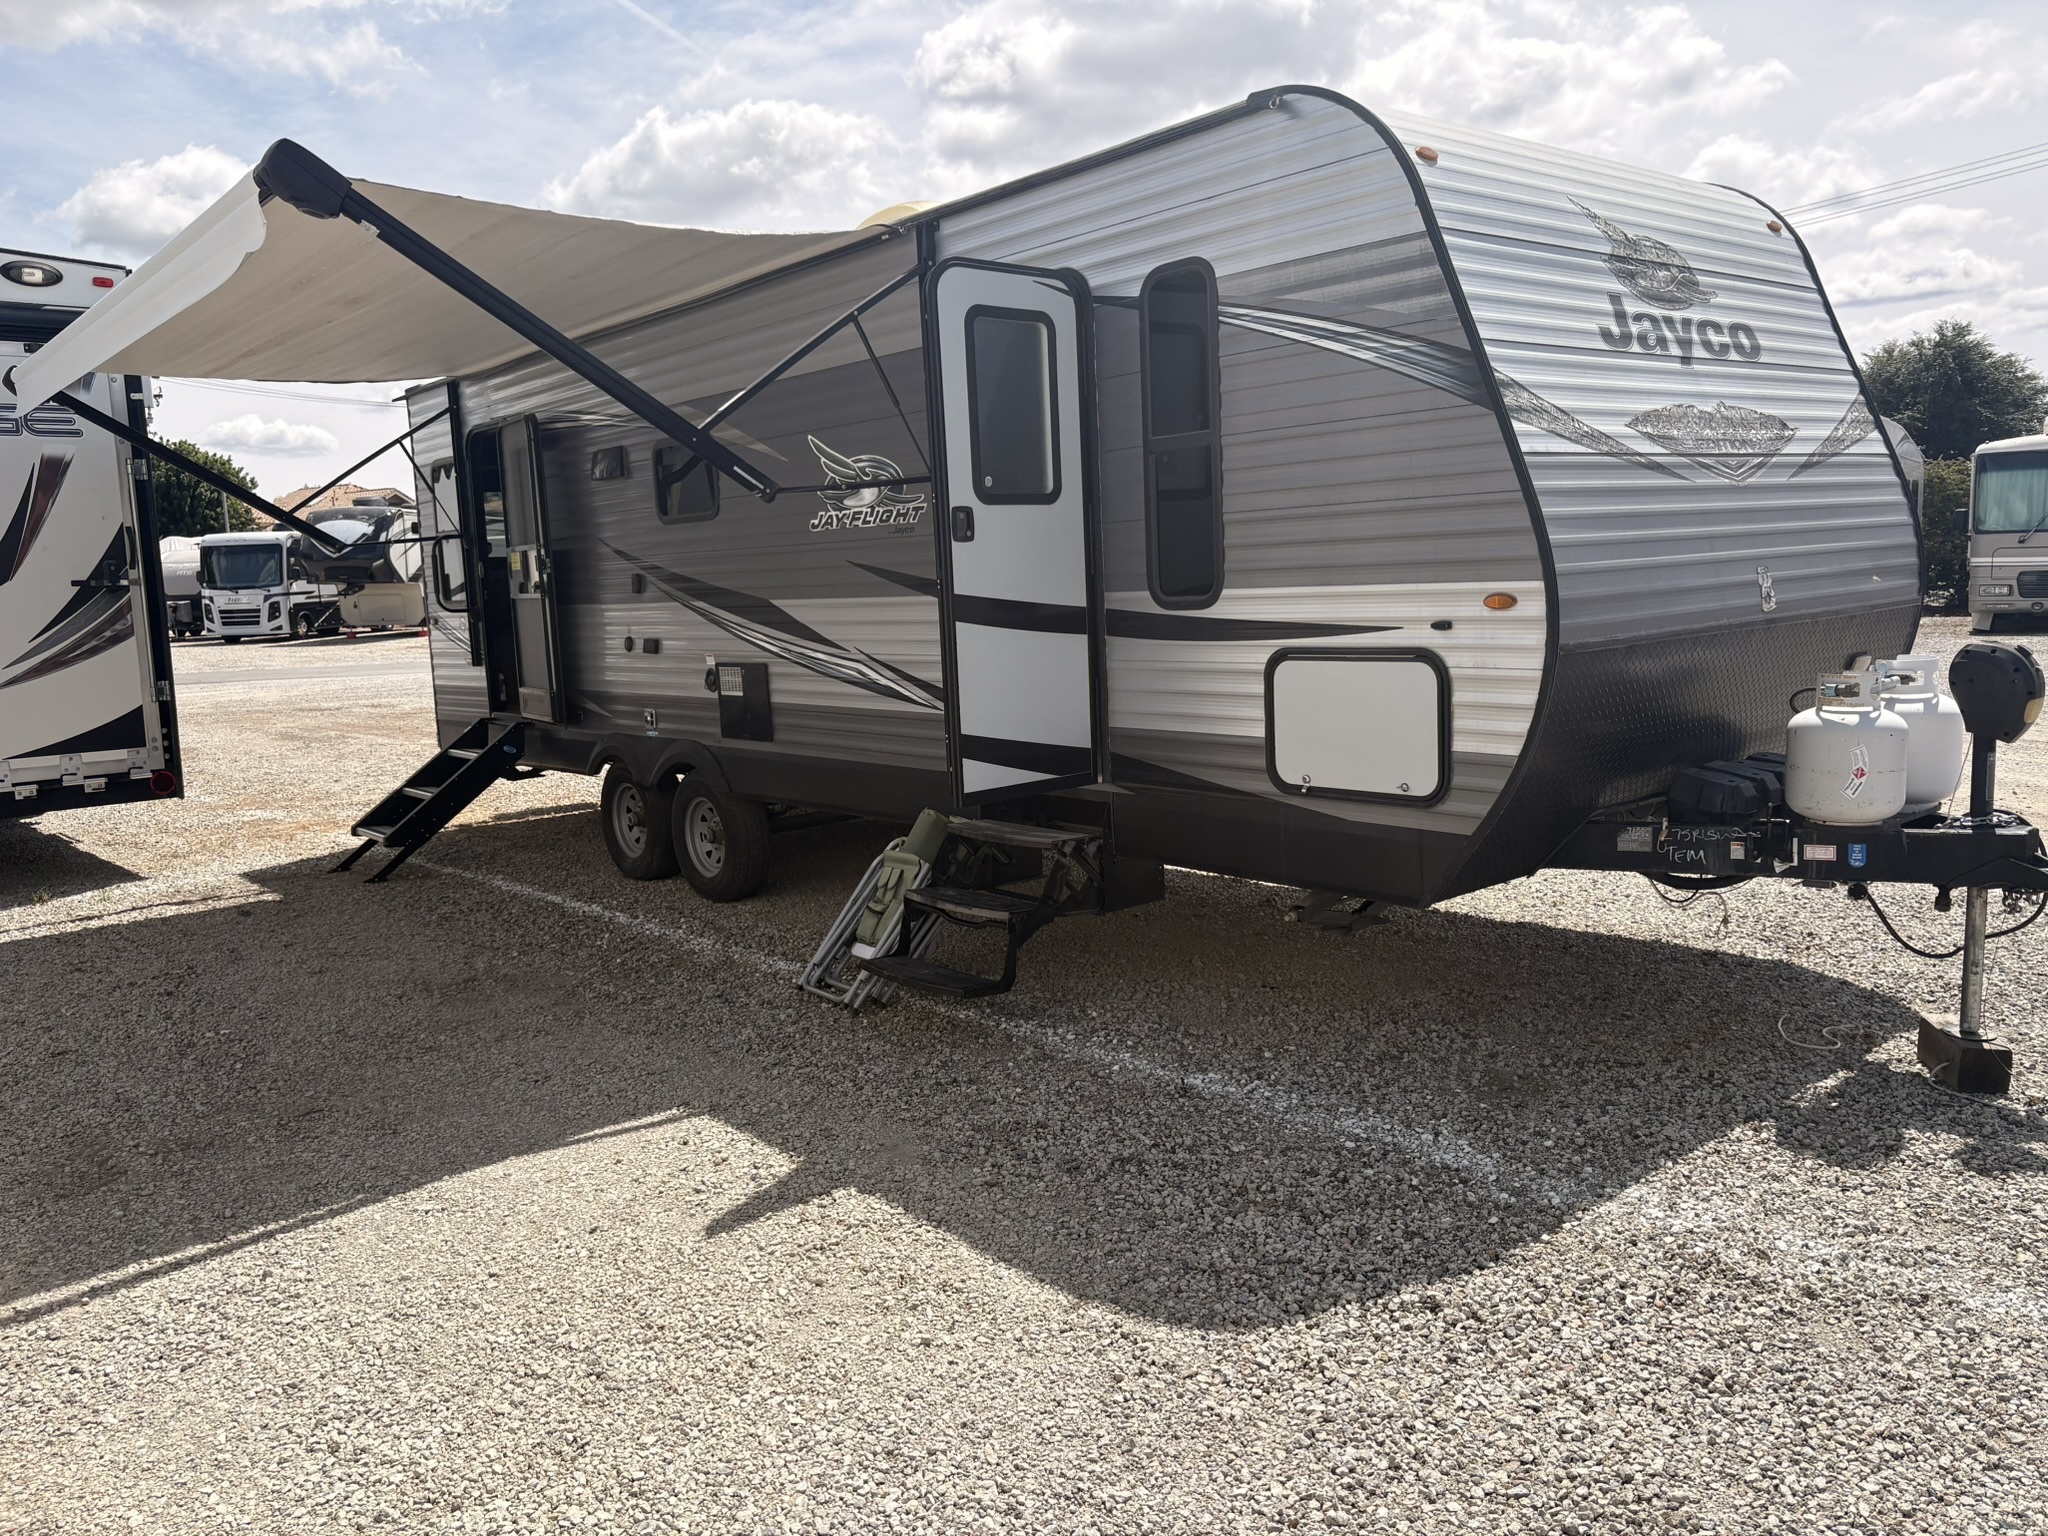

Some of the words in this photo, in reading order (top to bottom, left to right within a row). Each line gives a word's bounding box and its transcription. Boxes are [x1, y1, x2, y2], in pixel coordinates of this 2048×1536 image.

[1597, 292, 1762, 369] Jayco
[809, 511, 851, 531] JAY
[846, 503, 927, 528] FLIGHT
[892, 525, 915, 535] Jayco
